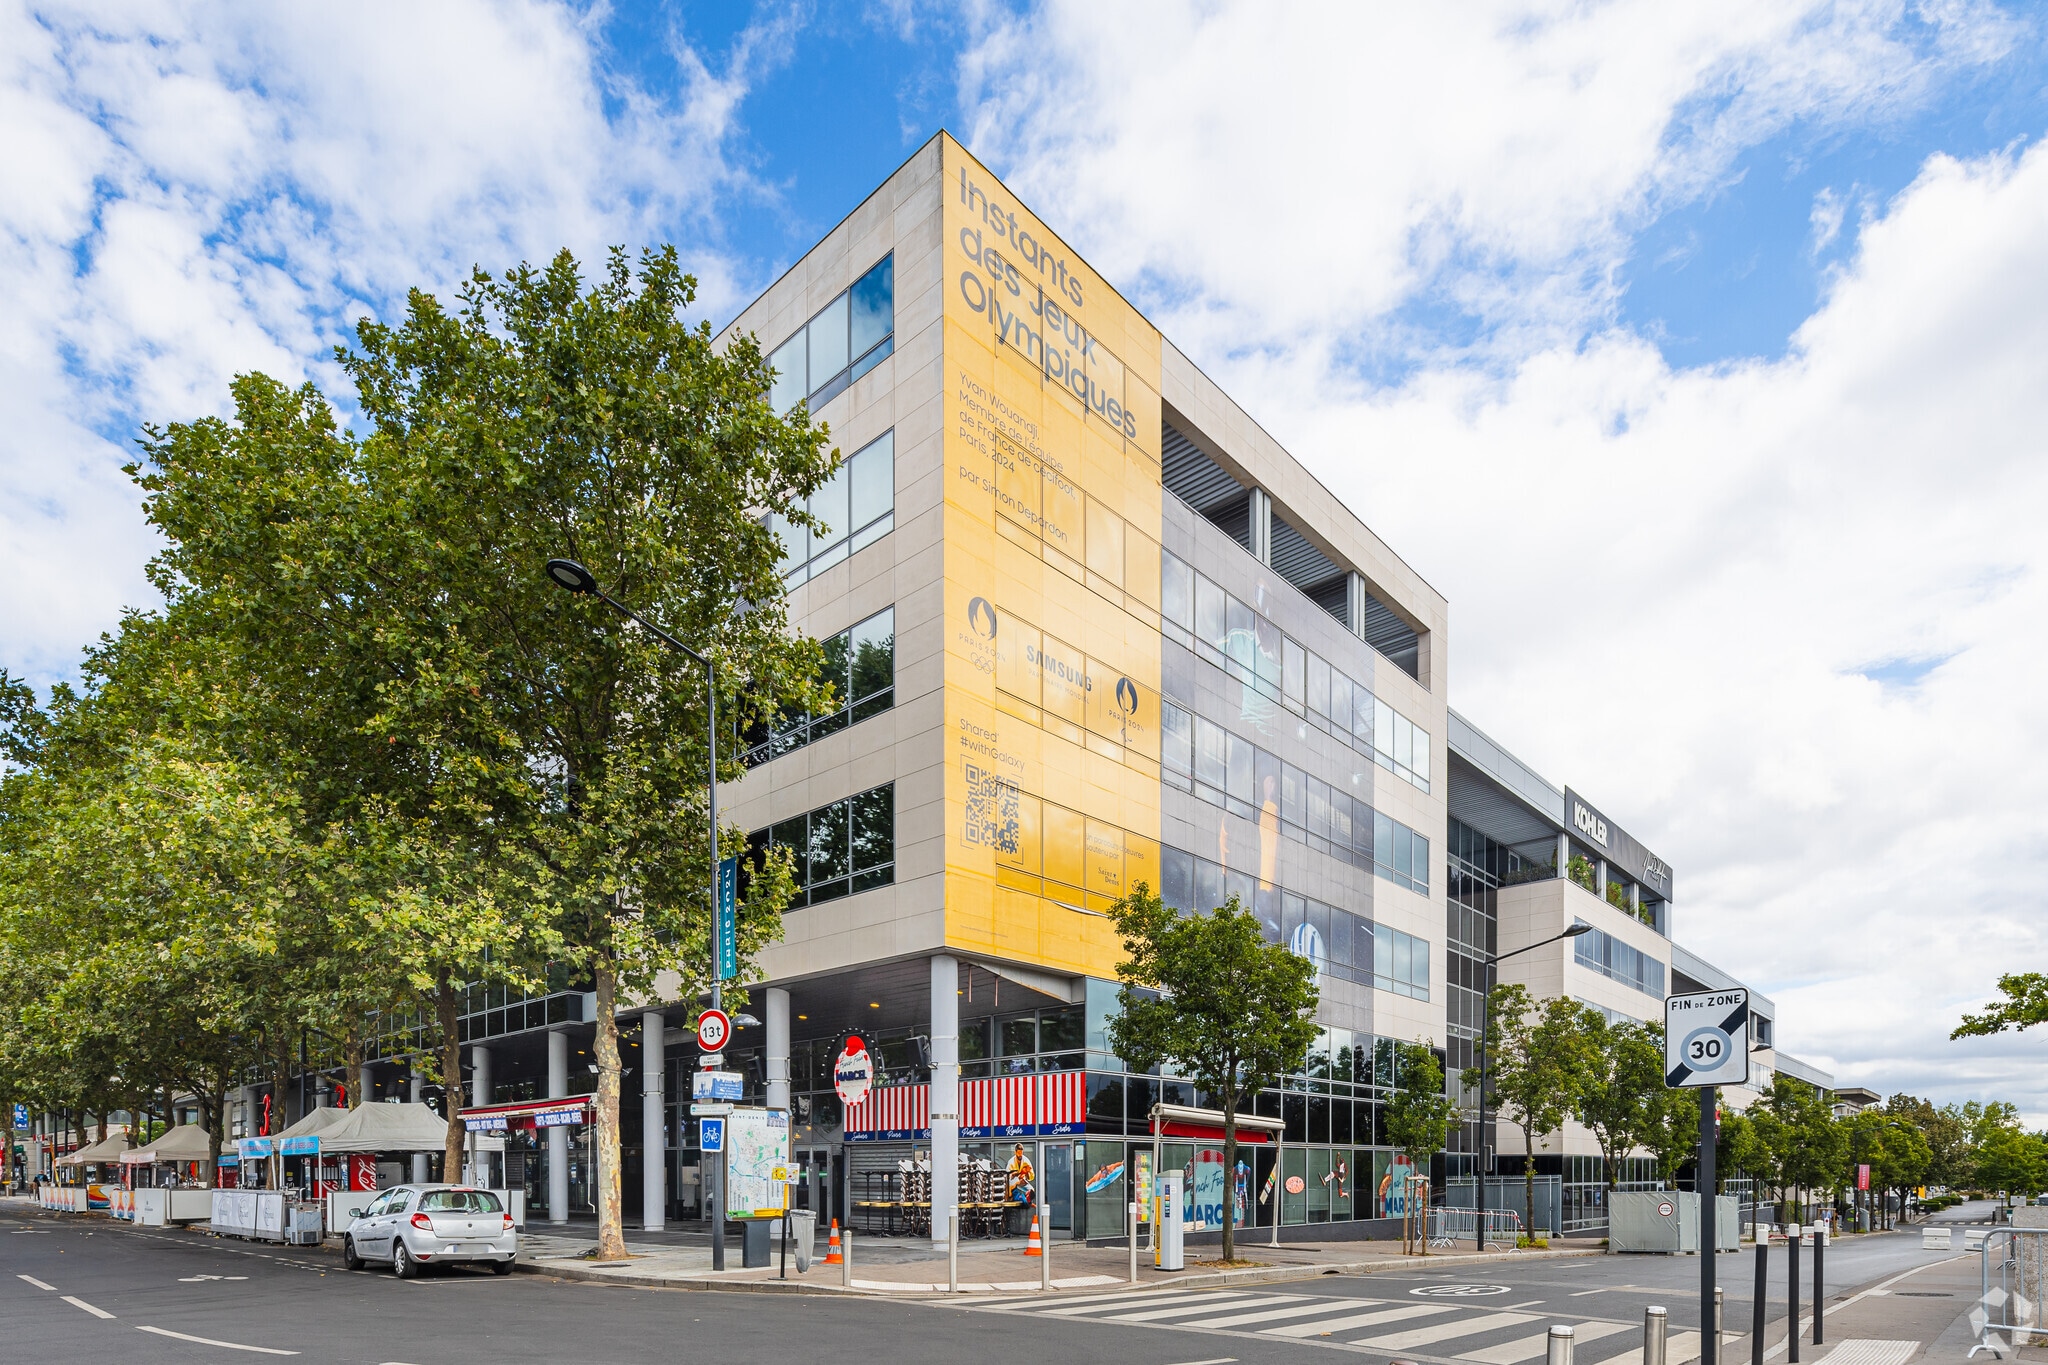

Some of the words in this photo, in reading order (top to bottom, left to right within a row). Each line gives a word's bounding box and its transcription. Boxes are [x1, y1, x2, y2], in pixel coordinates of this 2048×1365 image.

[960, 166, 1083, 308] Instants
[960, 226, 1021, 297] des
[1029, 283, 1097, 366] Jeux
[960, 270, 1137, 439] Olympiques
[959, 371, 987, 400] Yvan
[989, 393, 1040, 440] Wouandji,
[959, 390, 1007, 431] Membre
[1009, 425, 1023, 444] de
[959, 411, 975, 428] de
[977, 421, 1016, 456] France
[1017, 450, 1031, 467] de
[959, 427, 989, 458] Paris,
[991, 449, 1015, 473] 2024
[959, 465, 981, 485] par
[982, 478, 1016, 509] Simon
[1017, 501, 1068, 543] Depardon
[959, 633, 982, 650] PARIS
[1027, 645, 1092, 692] SAMSUNG
[960, 735, 1025, 773] #withGalaxy
[1573, 801, 1608, 848] KOHLER
[1671, 999, 1691, 1011] FIN
[1707, 994, 1741, 1007] ZONE
[702, 1025, 722, 1039] 13t
[1690, 1039, 1721, 1060] 30
[836, 1069, 867, 1081] MARCEL
[1211, 1170, 1224, 1193] Foo
[1183, 1203, 1239, 1226] MARCL
[1385, 1197, 1421, 1213] MARL
